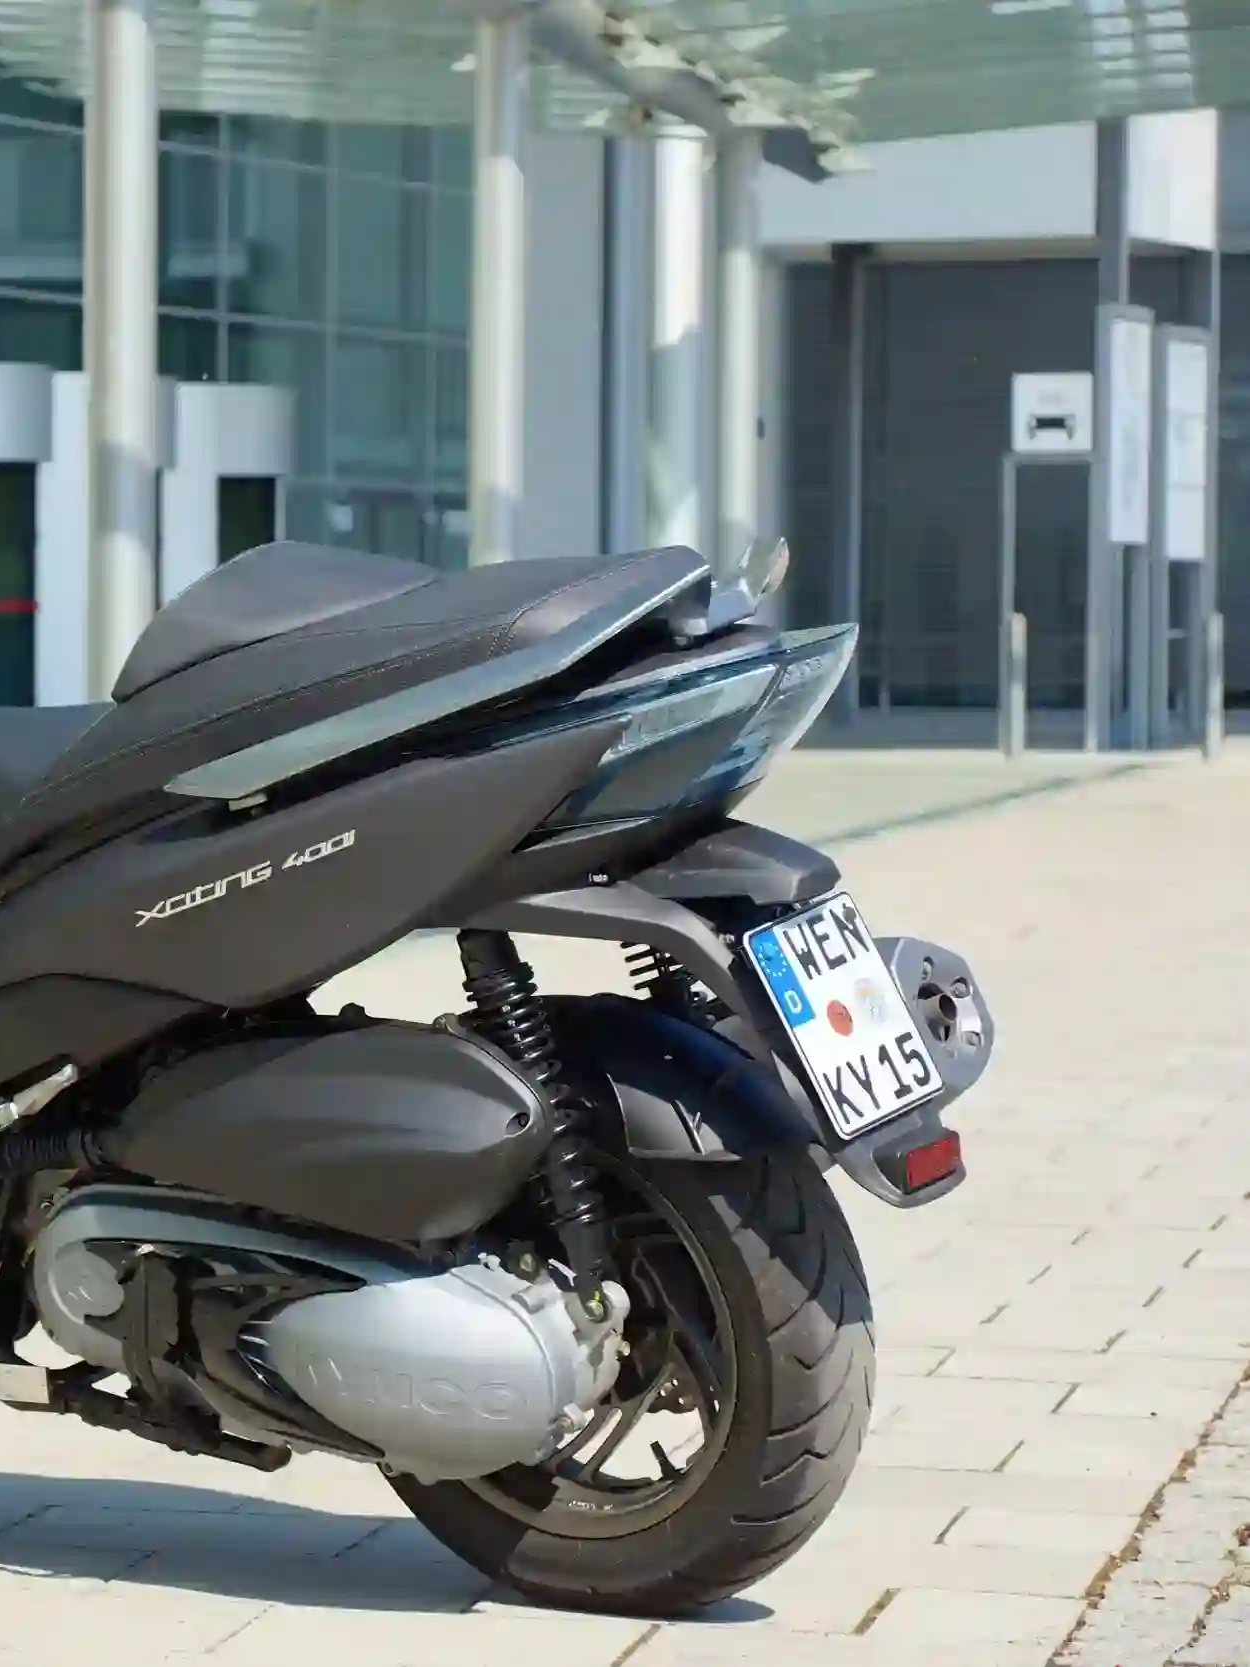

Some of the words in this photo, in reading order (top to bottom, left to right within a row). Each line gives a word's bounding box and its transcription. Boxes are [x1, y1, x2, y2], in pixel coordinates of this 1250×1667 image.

[784, 990, 802, 1014] D
[822, 1055, 881, 1124] KY
[878, 1032, 931, 1099] 15
